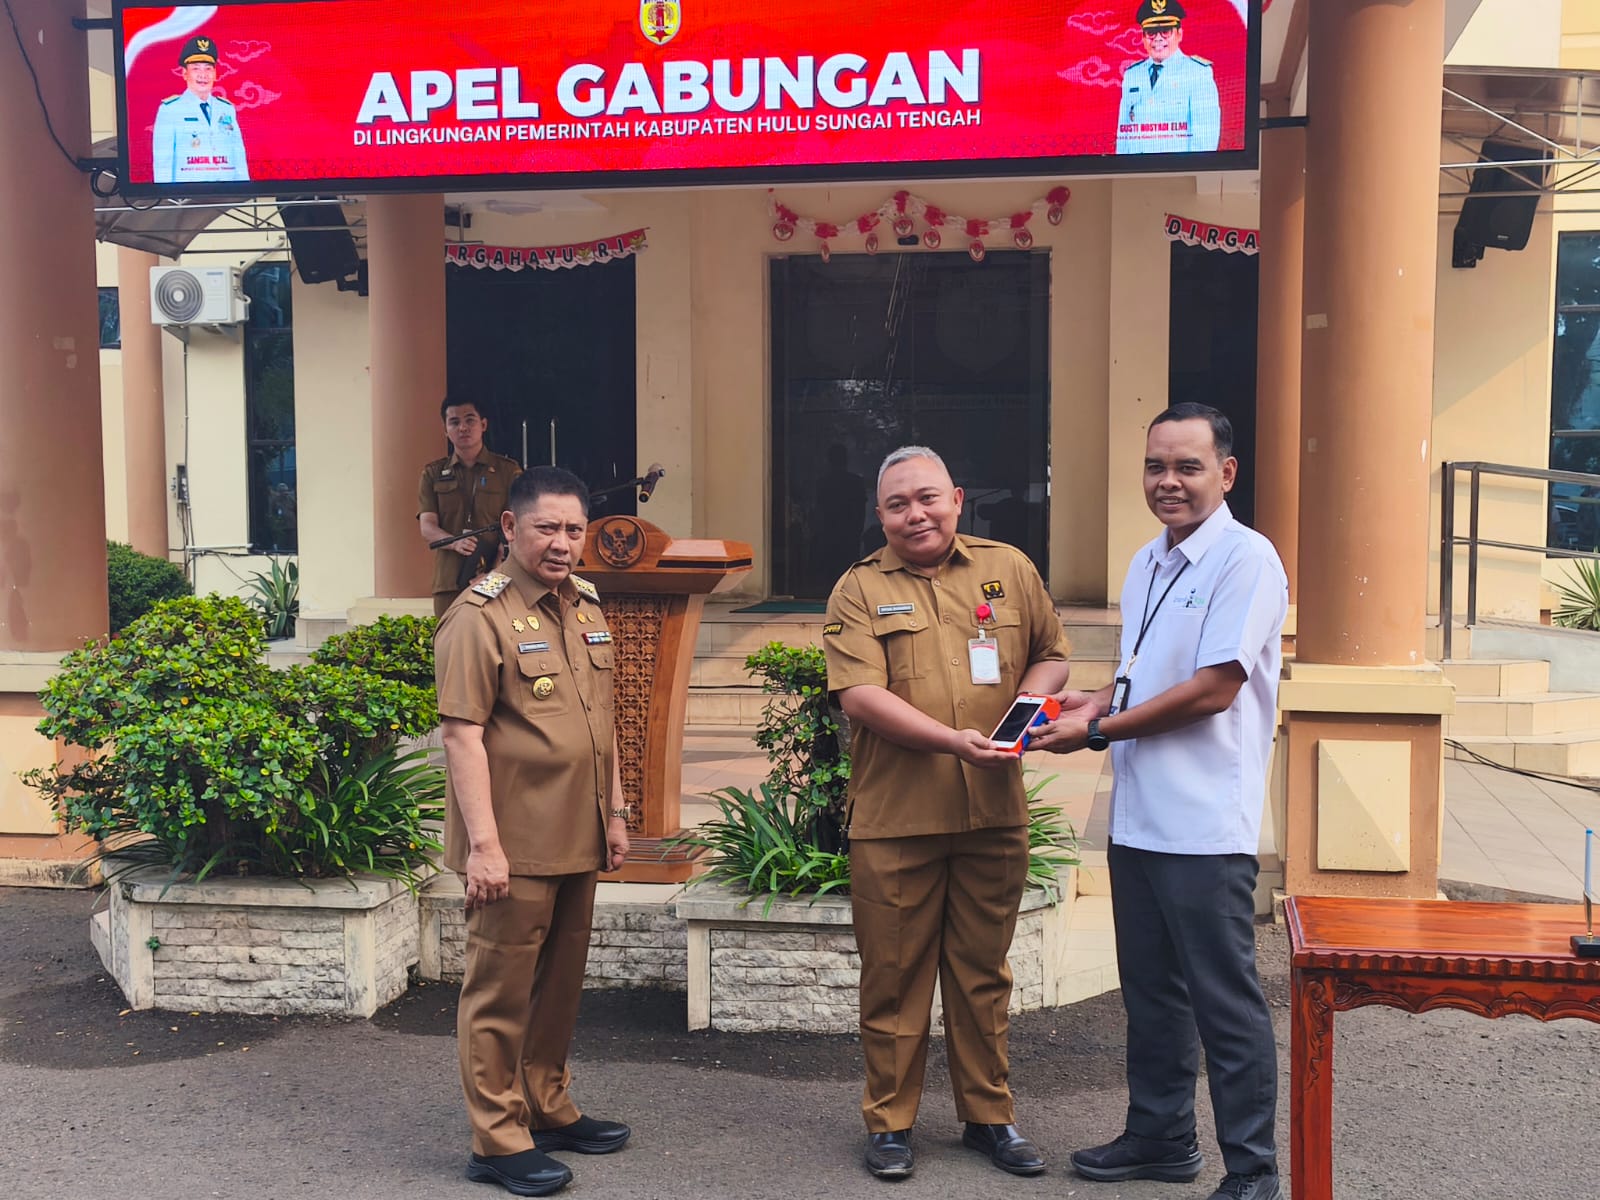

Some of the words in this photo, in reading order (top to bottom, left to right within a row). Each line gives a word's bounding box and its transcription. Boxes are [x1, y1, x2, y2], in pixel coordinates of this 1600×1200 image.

[356, 67, 540, 124] APEL
[557, 48, 980, 118] GABUNGAN
[353, 129, 372, 146] DI
[375, 125, 501, 146] LINGKUNGAN
[505, 121, 630, 141] PEMERINTAH
[634, 117, 753, 137] KABUPATEN
[757, 115, 811, 133] HULU
[815, 111, 892, 131] SUNGAI
[896, 108, 981, 128] TENGAH
[597, 238, 624, 258] RI
